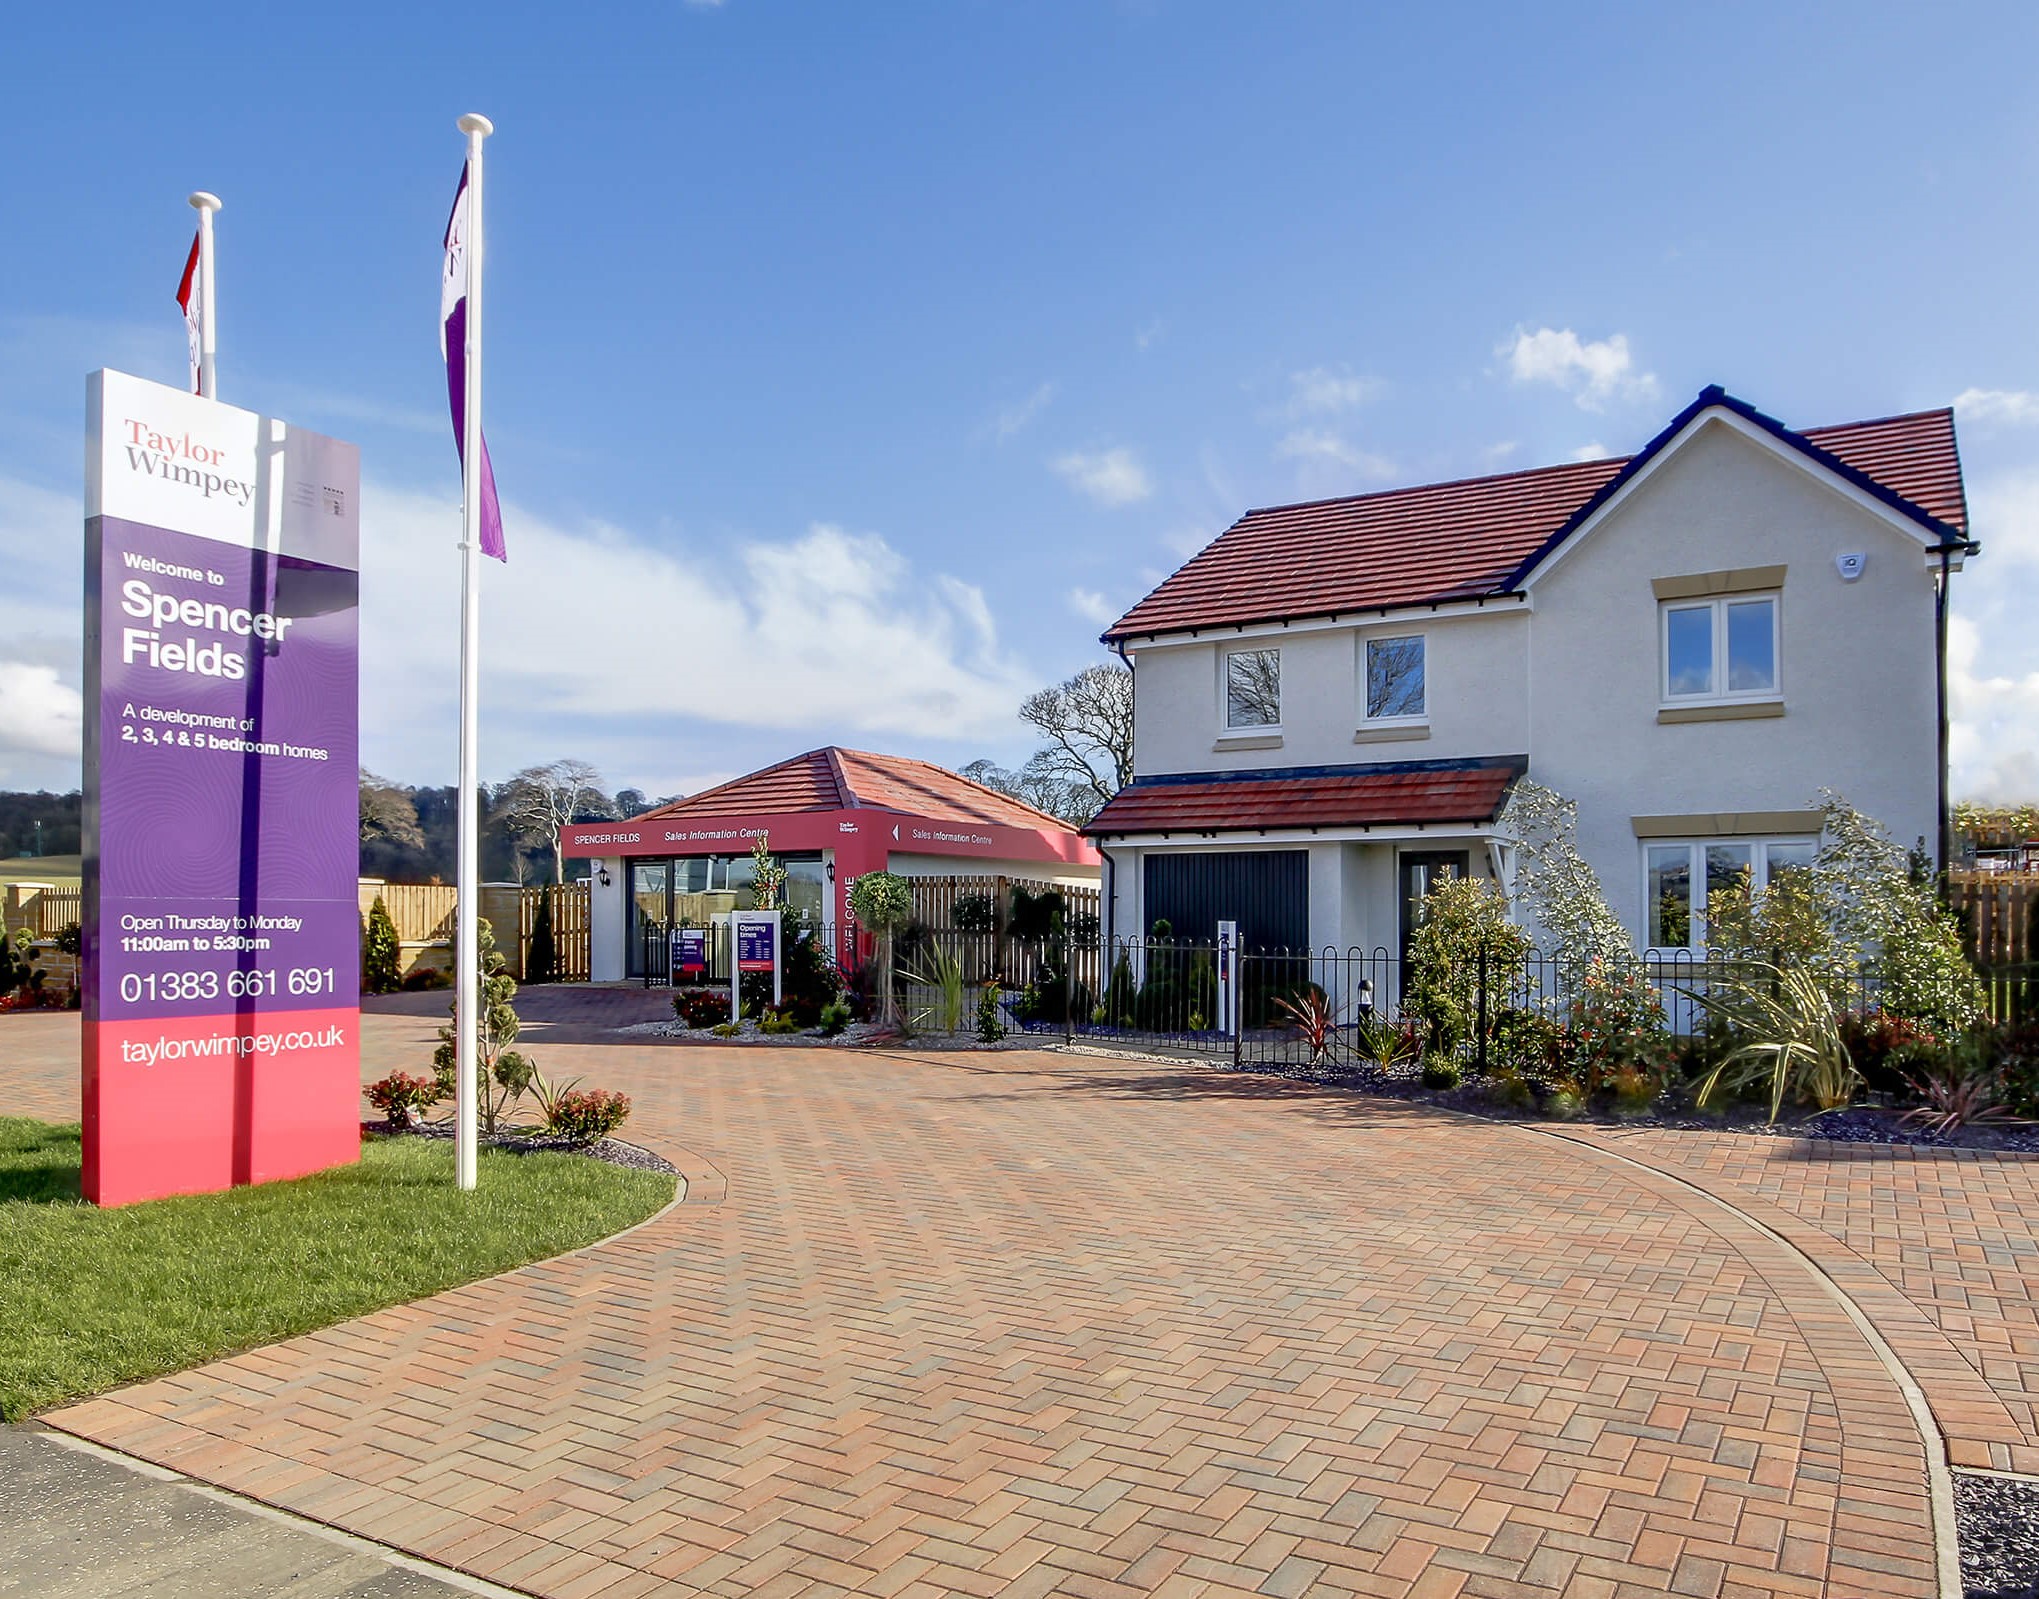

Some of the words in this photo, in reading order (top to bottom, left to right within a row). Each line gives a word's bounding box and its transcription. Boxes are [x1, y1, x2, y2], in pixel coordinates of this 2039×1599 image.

[124, 418, 225, 467] Taylor
[124, 445, 256, 507] Wimpey
[122, 551, 203, 582] Welcome
[206, 569, 225, 586] to
[121, 580, 294, 642] Spencer
[123, 627, 245, 680] Fields
[122, 703, 136, 719] A
[140, 705, 236, 731] development
[240, 717, 255, 732] of
[122, 725, 138, 744] 2,
[142, 727, 158, 746] 3,
[162, 730, 174, 745] 4
[177, 732, 192, 747] &
[194, 733, 205, 748] 5
[208, 734, 280, 756] bedroom
[282, 742, 329, 761] homes
[574, 834, 611, 845] SPENCER
[613, 833, 641, 843] FIELDS
[664, 832, 687, 841] Sales
[689, 829, 737, 840] Information
[739, 828, 769, 838] Centre
[912, 829, 931, 840] Sales
[933, 831, 970, 843] Information
[971, 834, 993, 845] Centre
[121, 915, 163, 934] Open
[166, 915, 230, 934] Thursday
[232, 915, 247, 930] to
[250, 915, 302, 932] Monday
[740, 925, 766, 933] Opening
[121, 937, 190, 952] 11:00am
[193, 937, 210, 952] to
[213, 936, 270, 954] 5:30pm
[120, 972, 218, 1003] 01383
[227, 969, 277, 998] 661
[287, 967, 335, 995] 691
[121, 1024, 344, 1067] taylorwimpey.co.uk
